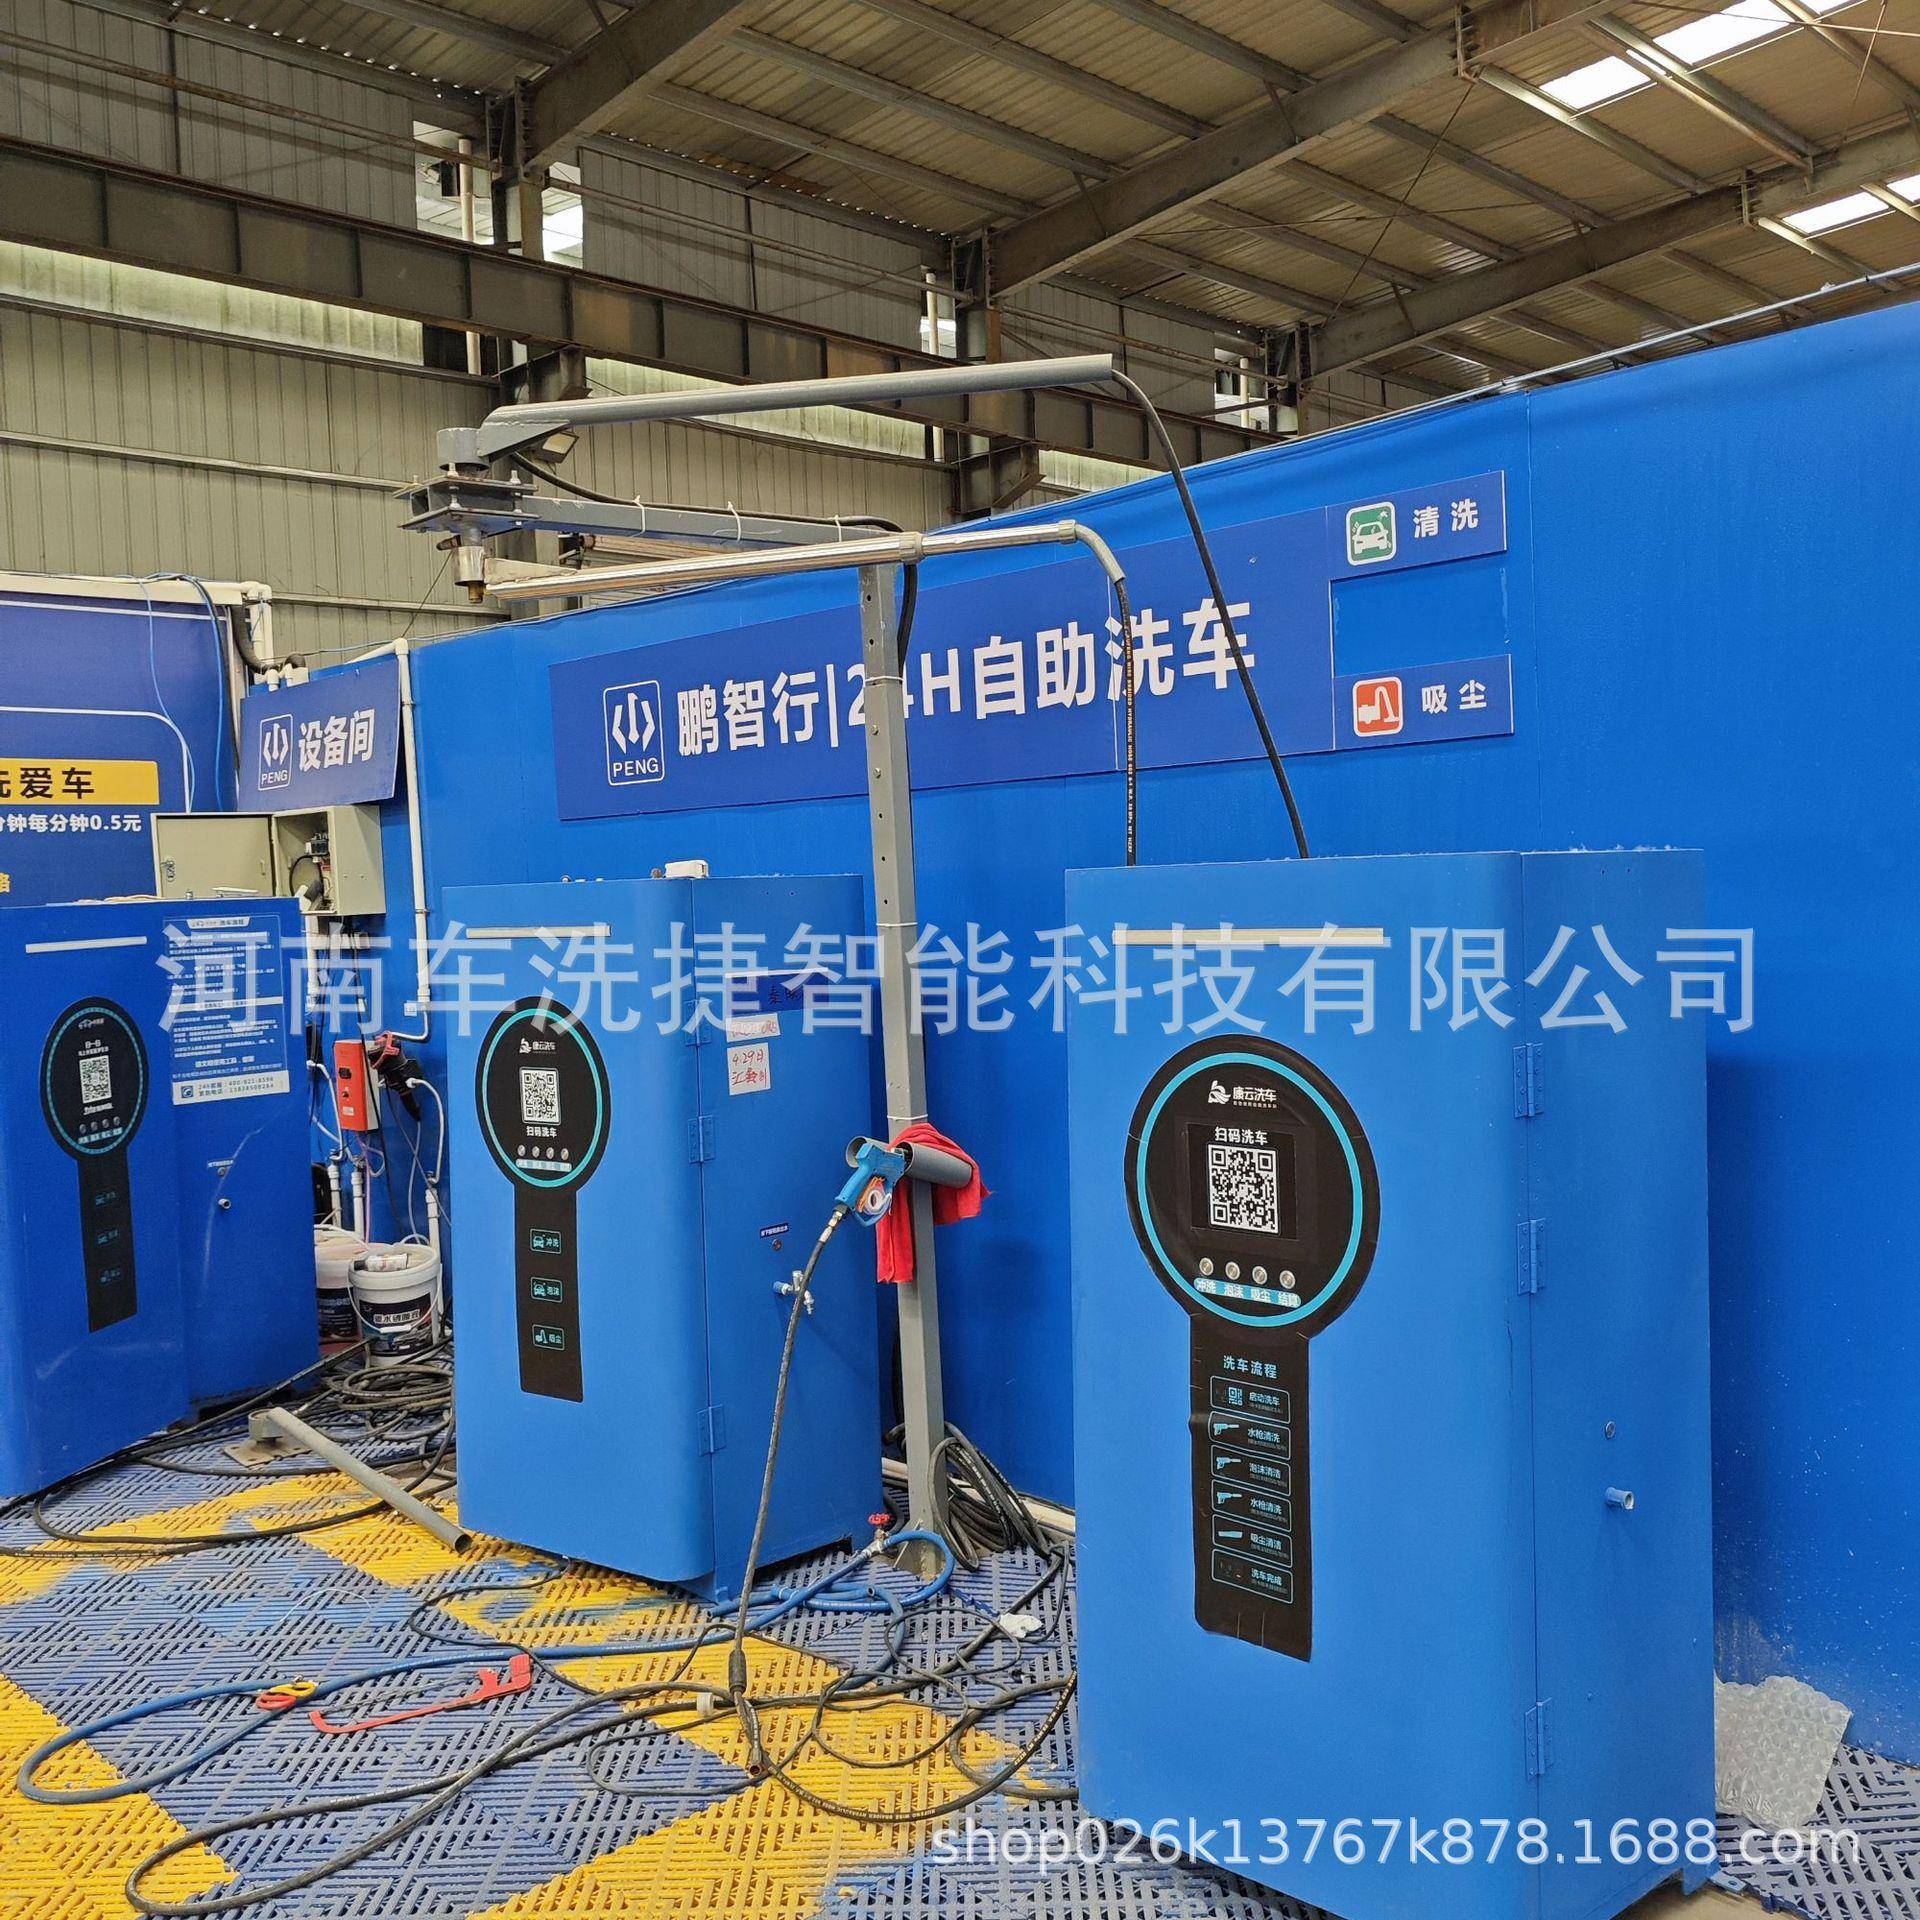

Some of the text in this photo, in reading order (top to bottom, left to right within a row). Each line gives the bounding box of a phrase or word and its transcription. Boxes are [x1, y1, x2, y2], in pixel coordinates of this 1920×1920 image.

[1413, 499, 1479, 539] 清洗
[1422, 679, 1488, 714] 吸尘
[298, 708, 375, 772] 设备间
[613, 757, 659, 777] PENG
[261, 769, 288, 785] PENG
[526, 1126, 558, 1138] 扫码洗车
[1215, 1126, 1268, 1146] 扫码洗车
[1223, 1355, 1277, 1379] 洗车流程
[1249, 1391, 1280, 1406] 启动洗车
[1248, 1428, 1280, 1444] 水枪清洗
[1249, 1462, 1281, 1479] 泡沫清洁
[1250, 1498, 1282, 1515] 水枪清洗
[1250, 1532, 1282, 1550] 吸尘清洁
[1251, 1567, 1282, 1586] 洗车完成
